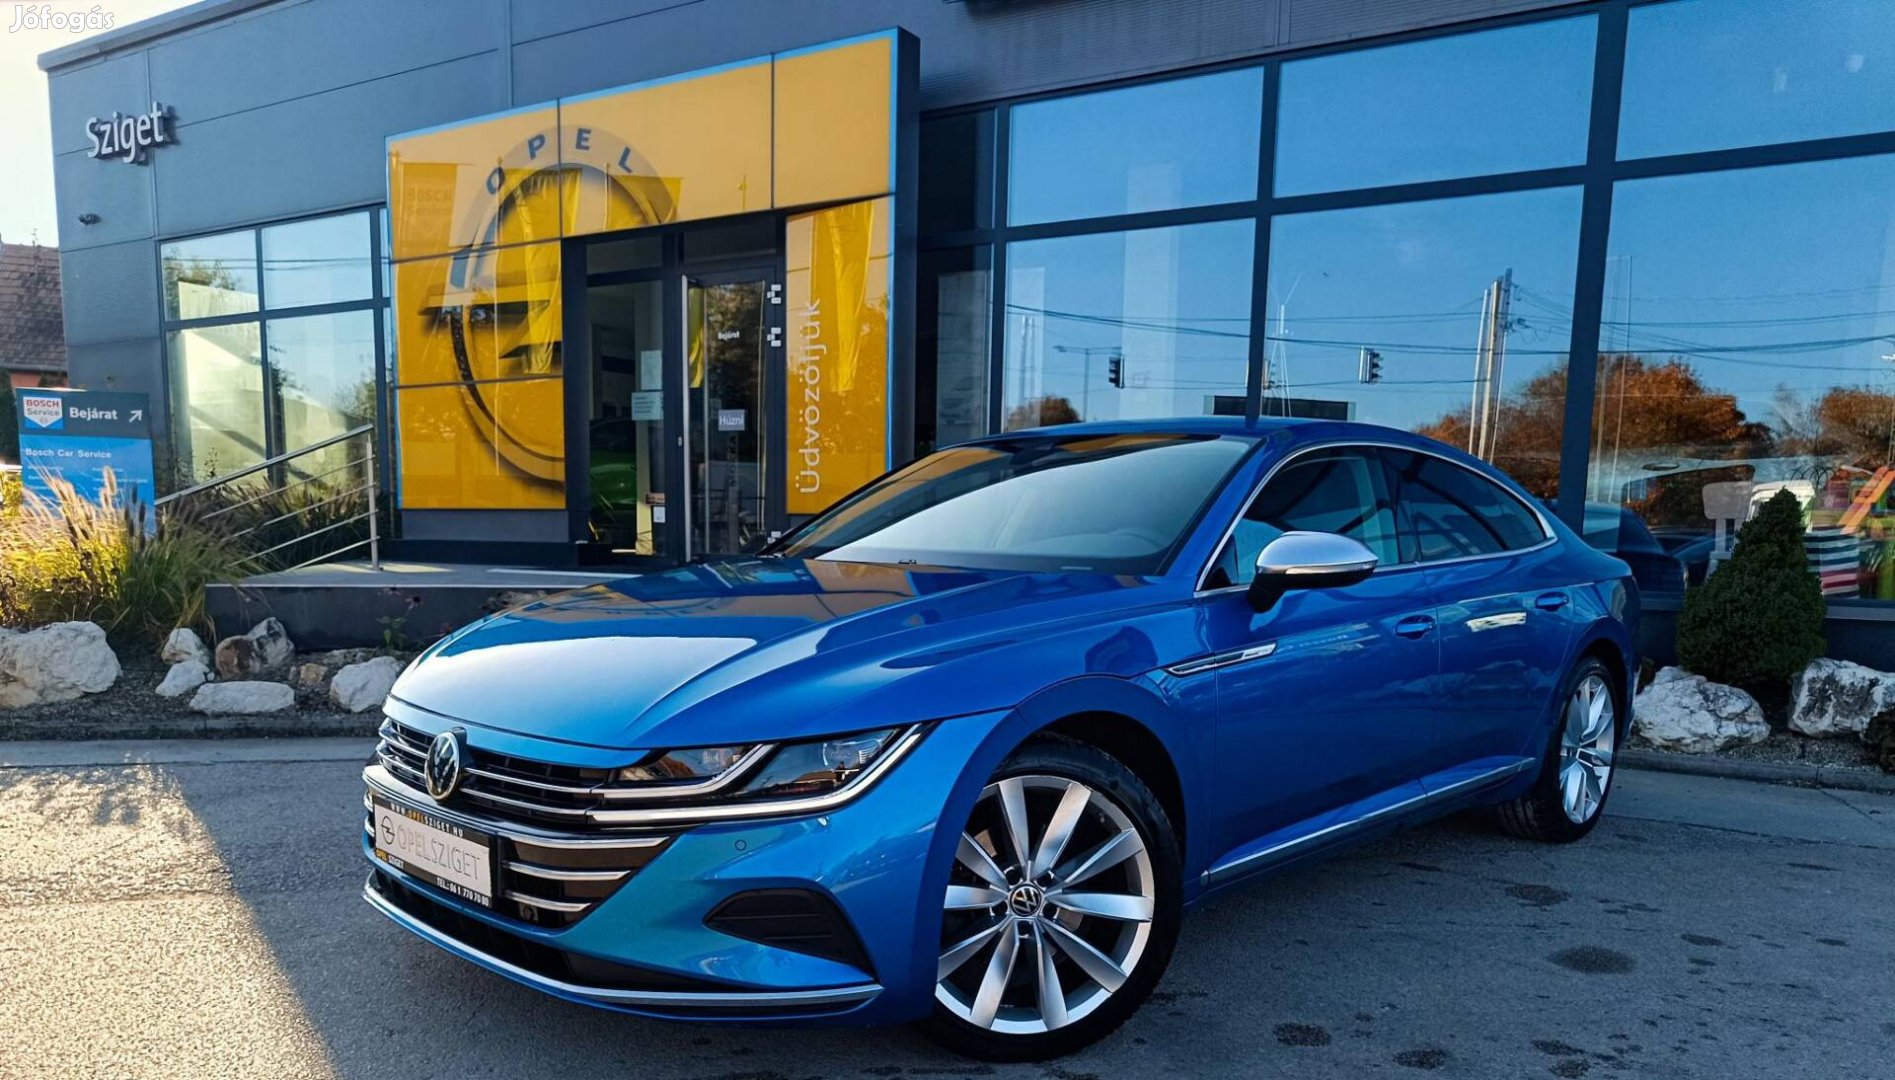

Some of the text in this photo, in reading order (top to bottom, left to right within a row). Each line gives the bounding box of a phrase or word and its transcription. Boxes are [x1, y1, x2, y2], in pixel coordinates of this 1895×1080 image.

[85, 101, 163, 163] Sziget
[486, 127, 632, 195] OPEL
[795, 298, 827, 493] Üdvözöljük
[26, 399, 59, 407] BOSCH
[27, 408, 60, 416] Service
[69, 407, 118, 421] Bejárat
[25, 448, 112, 459] Bosch Car Service
